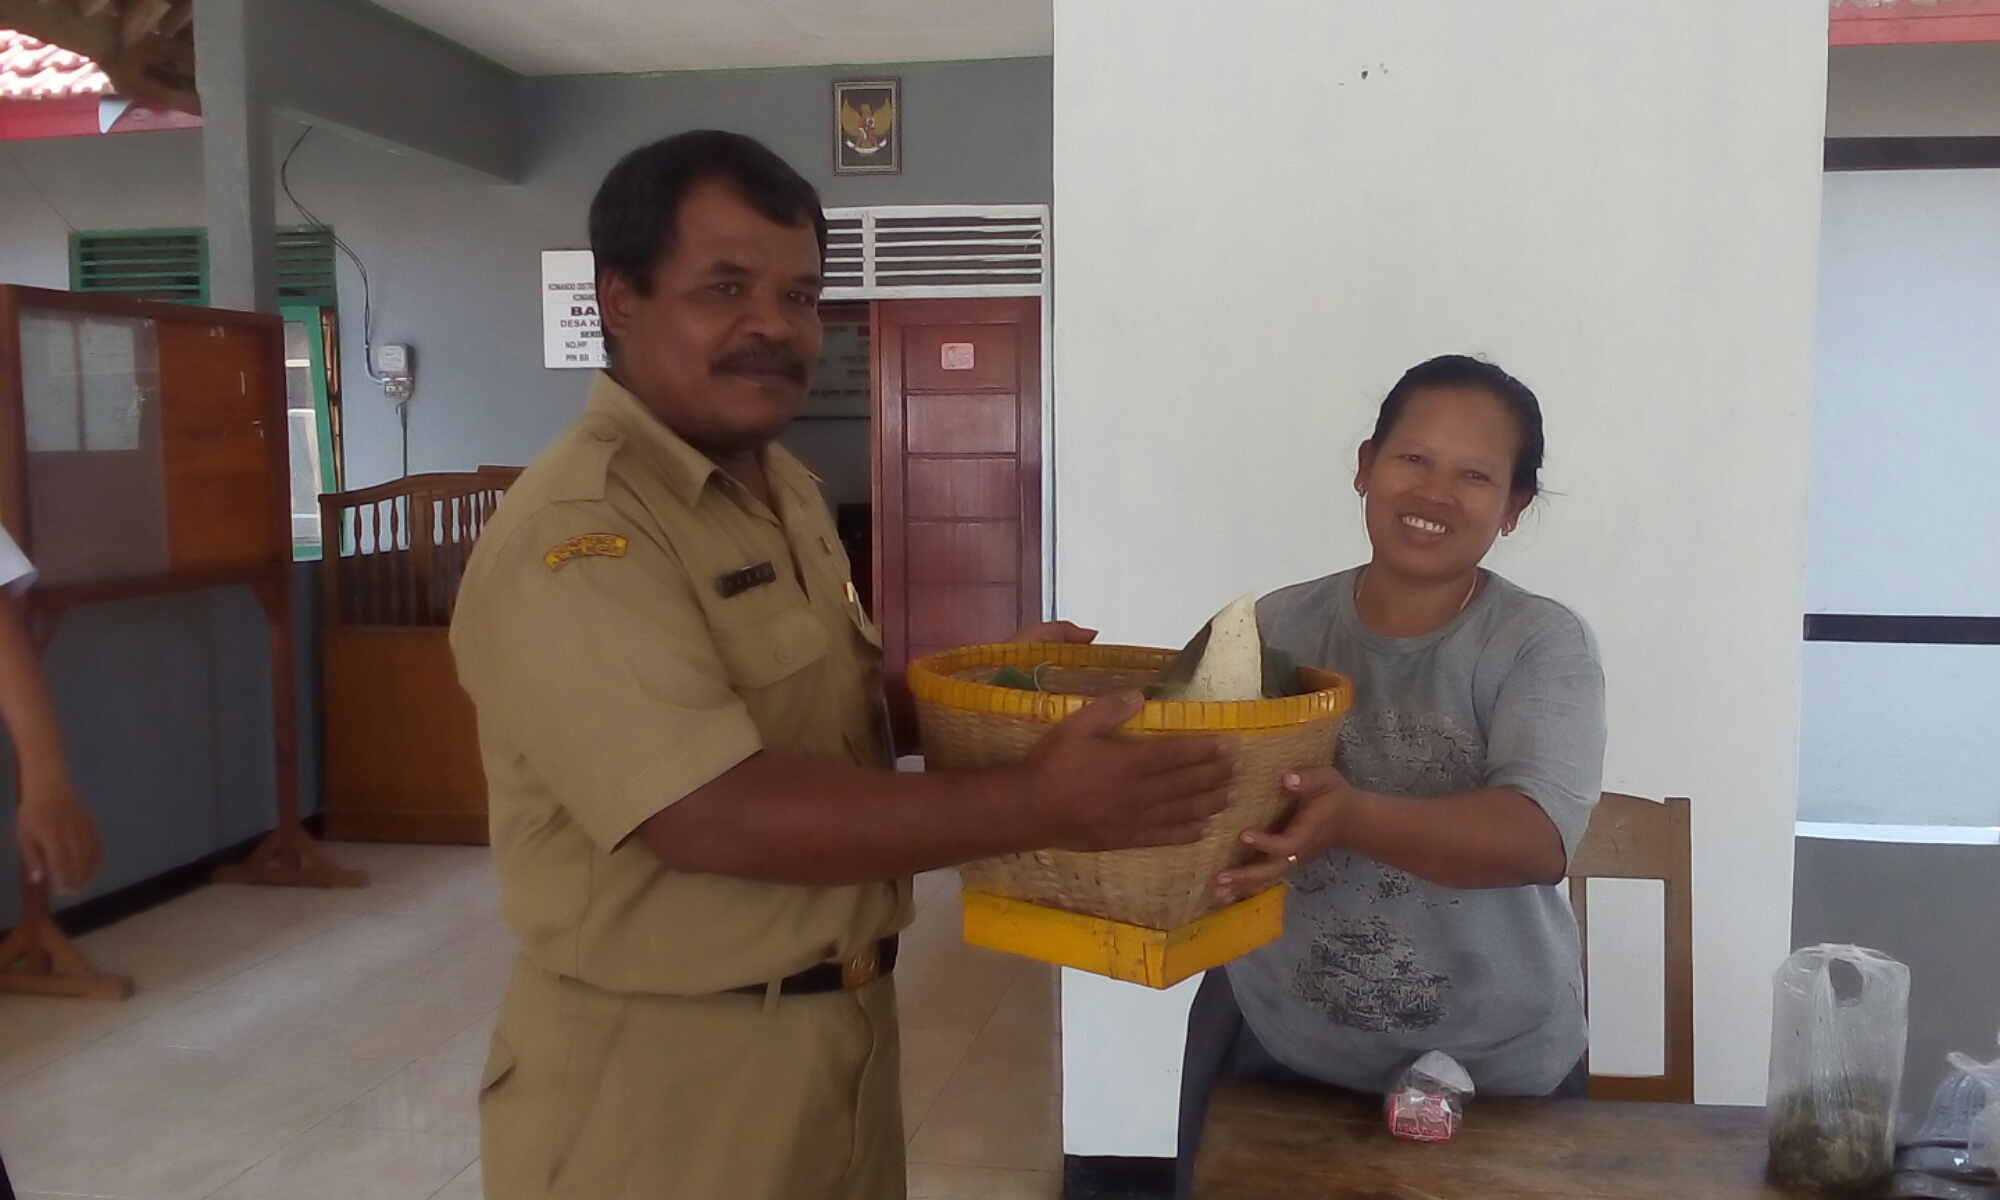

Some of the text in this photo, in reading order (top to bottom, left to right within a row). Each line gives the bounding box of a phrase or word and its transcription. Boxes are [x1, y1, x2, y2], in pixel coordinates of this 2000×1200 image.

[548, 283, 576, 291] KOMANDO
[560, 320, 587, 328] DESA
[566, 353, 578, 361] PIN
